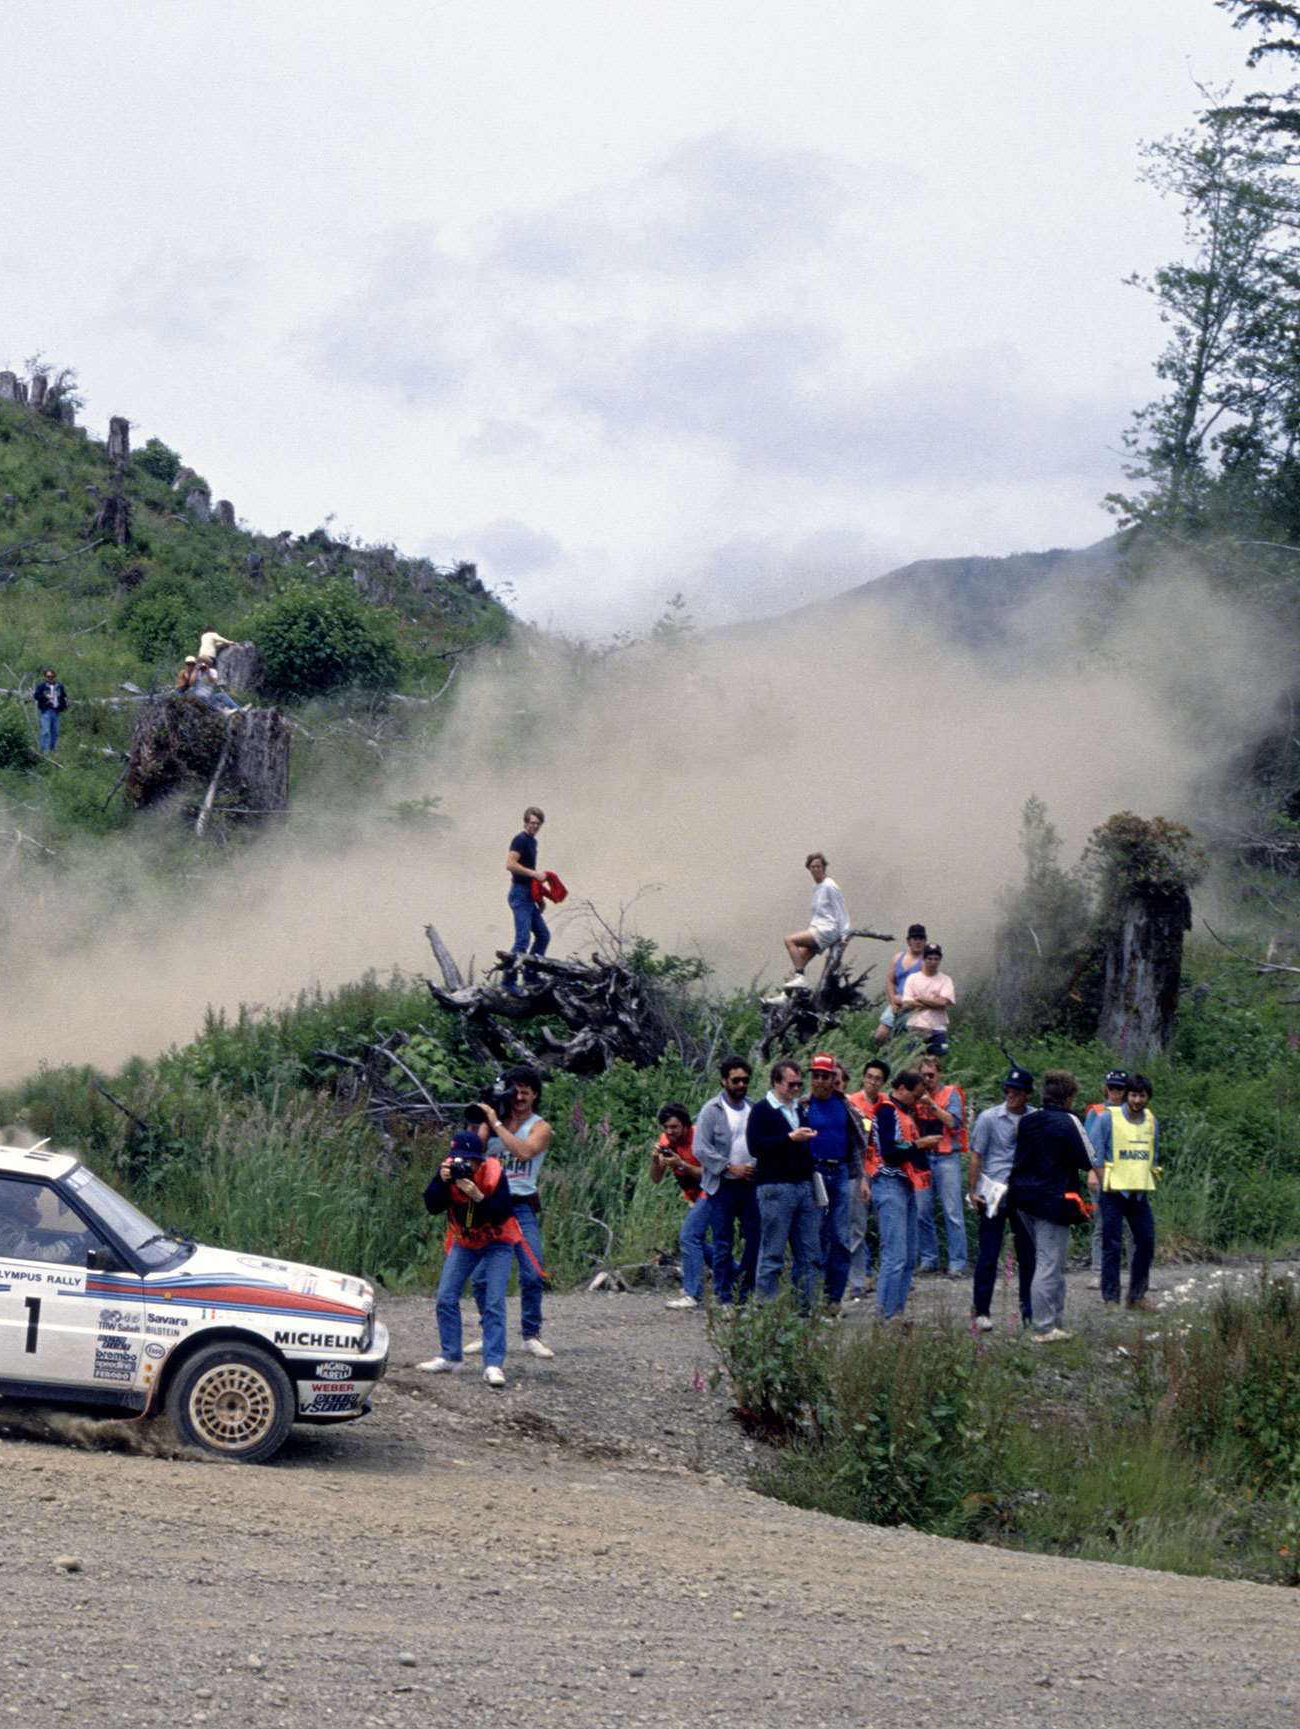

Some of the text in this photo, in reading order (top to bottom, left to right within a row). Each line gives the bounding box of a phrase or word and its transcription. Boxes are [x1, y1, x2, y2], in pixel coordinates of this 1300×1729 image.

[46, 1275, 81, 1286] RALLY
[24, 1296, 41, 1354] 1
[147, 1313, 189, 1327] Savara
[146, 1326, 180, 1337] BILSTEIN
[274, 1331, 363, 1349] MICHELIN
[95, 1348, 138, 1361] brembo
[95, 1370, 129, 1379] FERODO
[311, 1383, 355, 1392] WEBER
